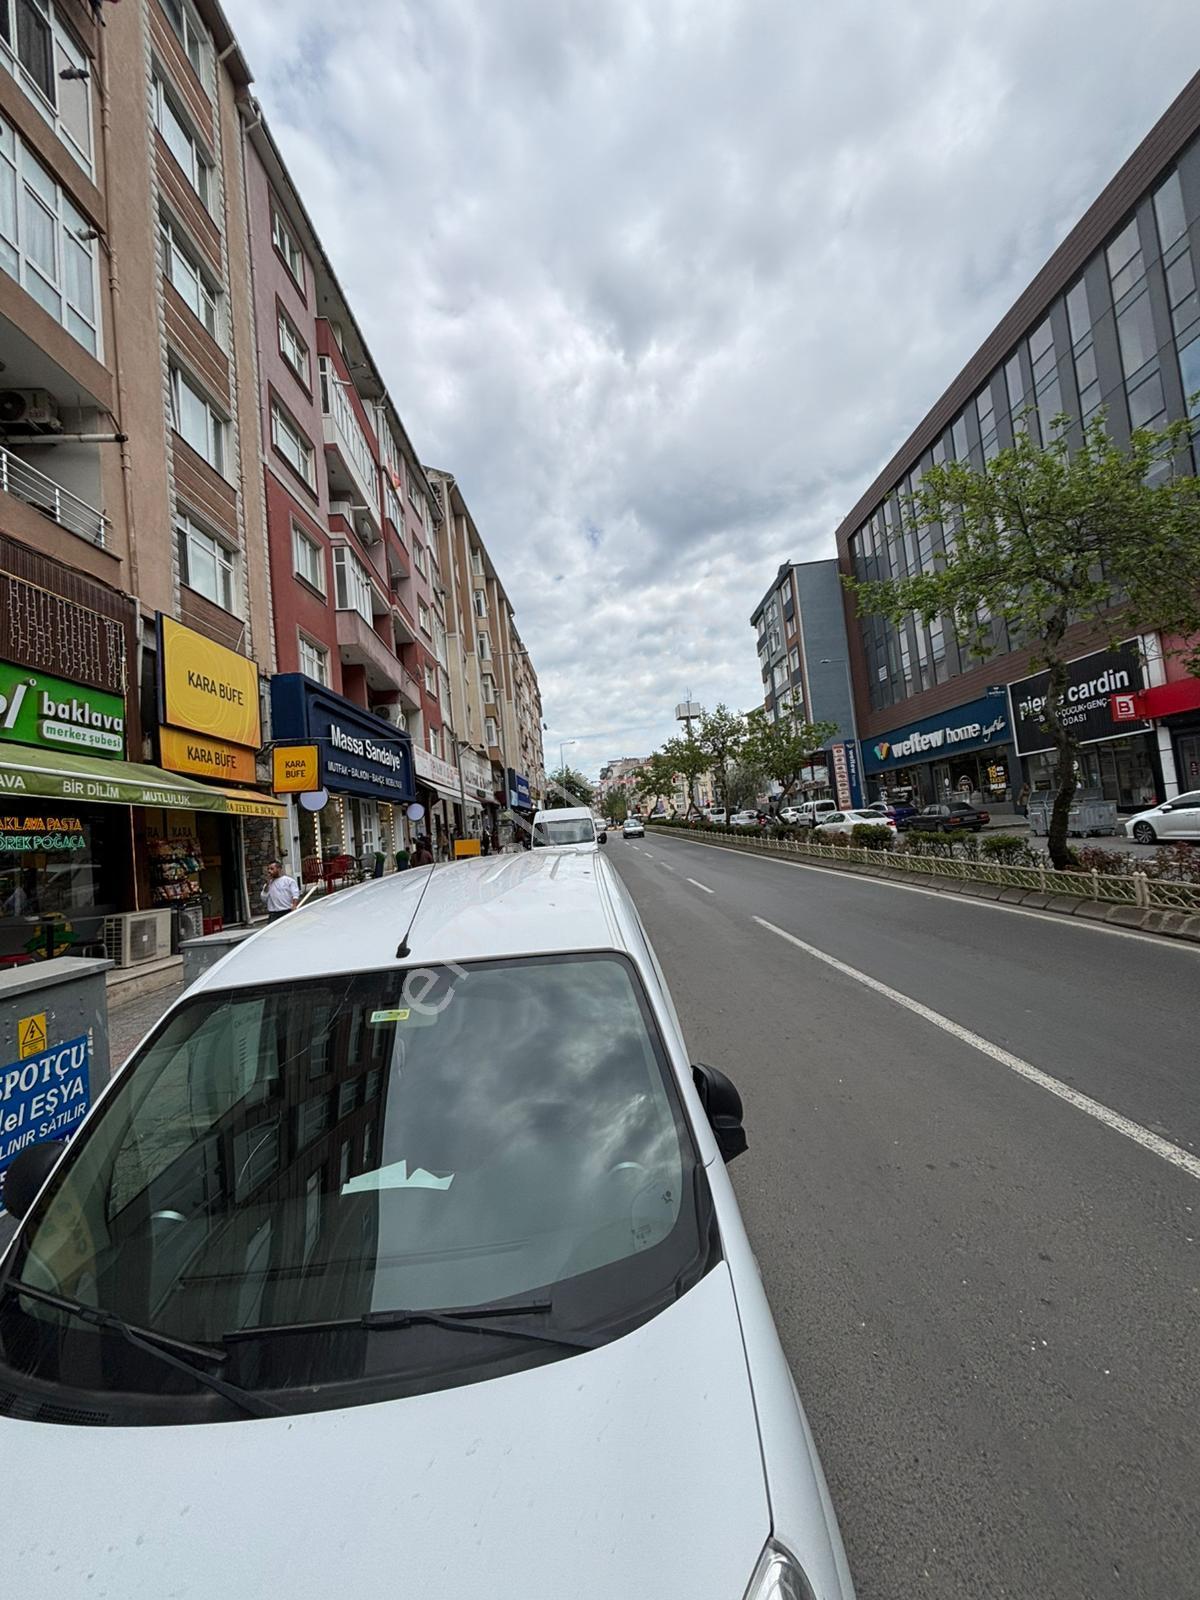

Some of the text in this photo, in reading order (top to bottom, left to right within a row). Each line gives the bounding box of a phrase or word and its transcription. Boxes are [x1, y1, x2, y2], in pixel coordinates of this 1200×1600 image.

[187, 669, 244, 706] KARA BÜFE
[1067, 668, 1130, 702] cardin
[43, 691, 123, 731] baklava
[1086, 697, 1108, 709] GENÇ
[1062, 713, 1087, 726] ODASI
[46, 725, 121, 748] merkez şubesi
[945, 723, 980, 744] home
[187, 745, 237, 769] KARA BÜFE
[331, 724, 364, 756] Massa
[365, 740, 400, 772] Sandalye
[285, 760, 306, 769] KARA
[285, 769, 306, 778] BÜFE
[327, 760, 349, 776] MUTFAK
[63, 779, 85, 794] BİR
[87, 782, 120, 798] DİLİM
[142, 790, 191, 805] MUTLULUK
[46, 817, 83, 831] PASTA
[0, 1042, 87, 1100] POTÇU
[30, 1076, 84, 1121] EŞYA
[39, 1102, 87, 1138] SATILIR
